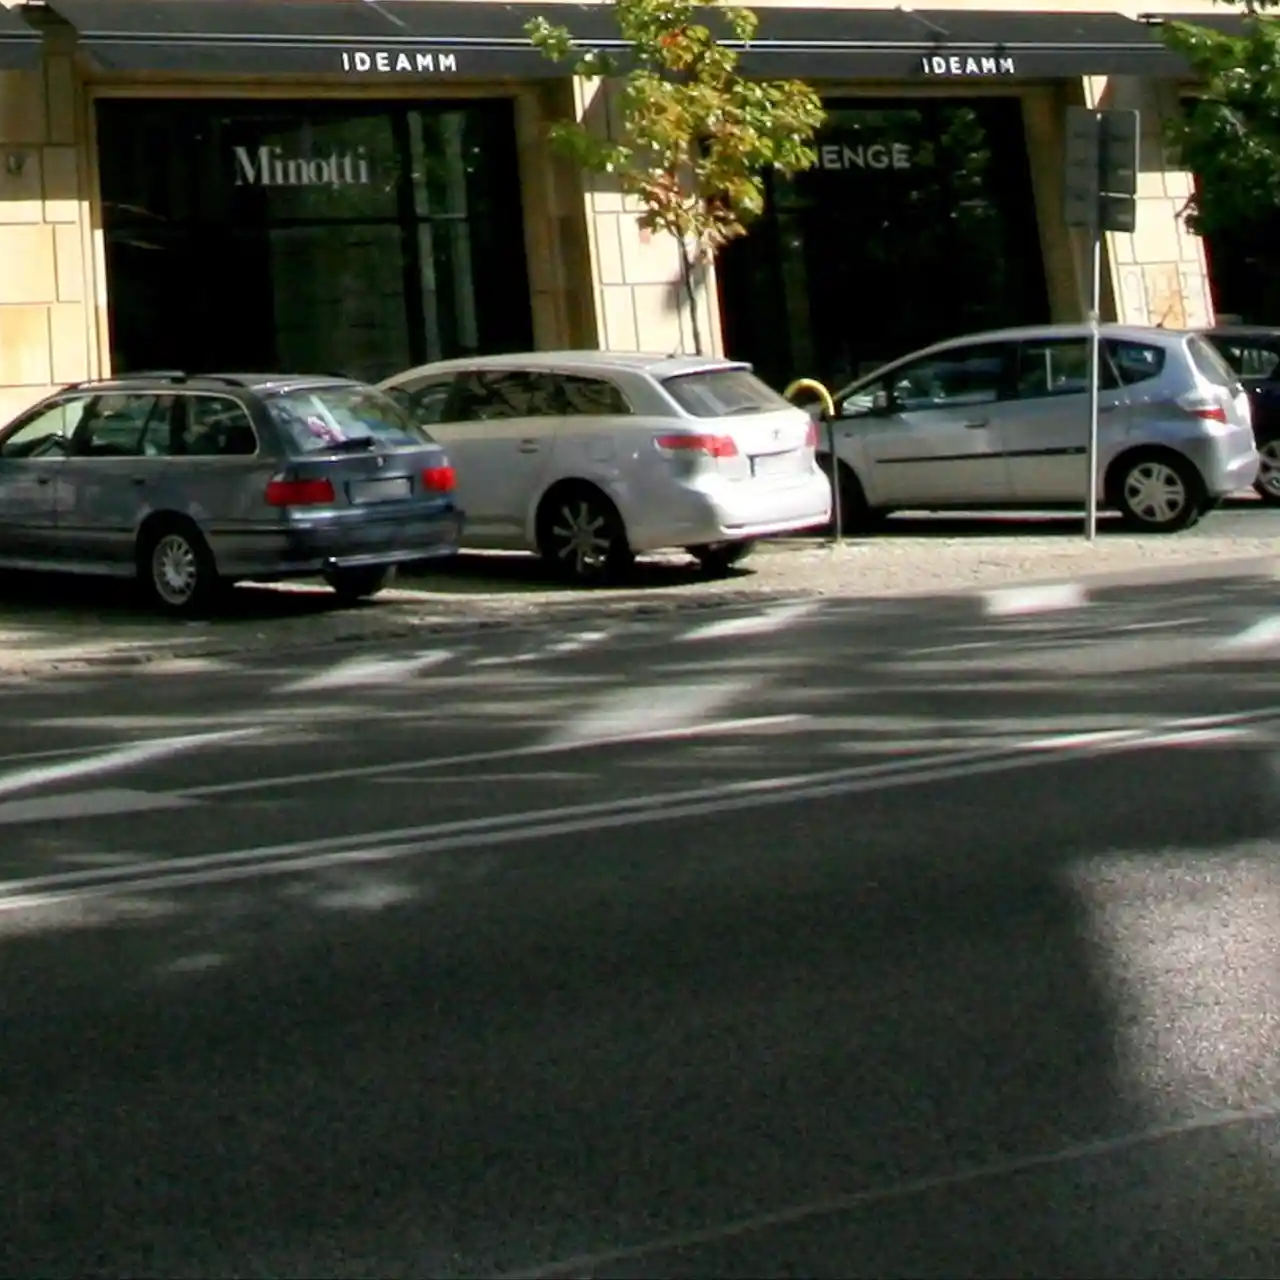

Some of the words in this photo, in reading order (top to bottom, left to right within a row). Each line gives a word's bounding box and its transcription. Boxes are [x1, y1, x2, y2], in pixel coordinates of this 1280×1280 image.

[341, 51, 458, 72] IDEAMM
[922, 56, 1016, 75] IDEAMM
[232, 144, 371, 187] Minotti
[814, 141, 913, 170] ENGE
